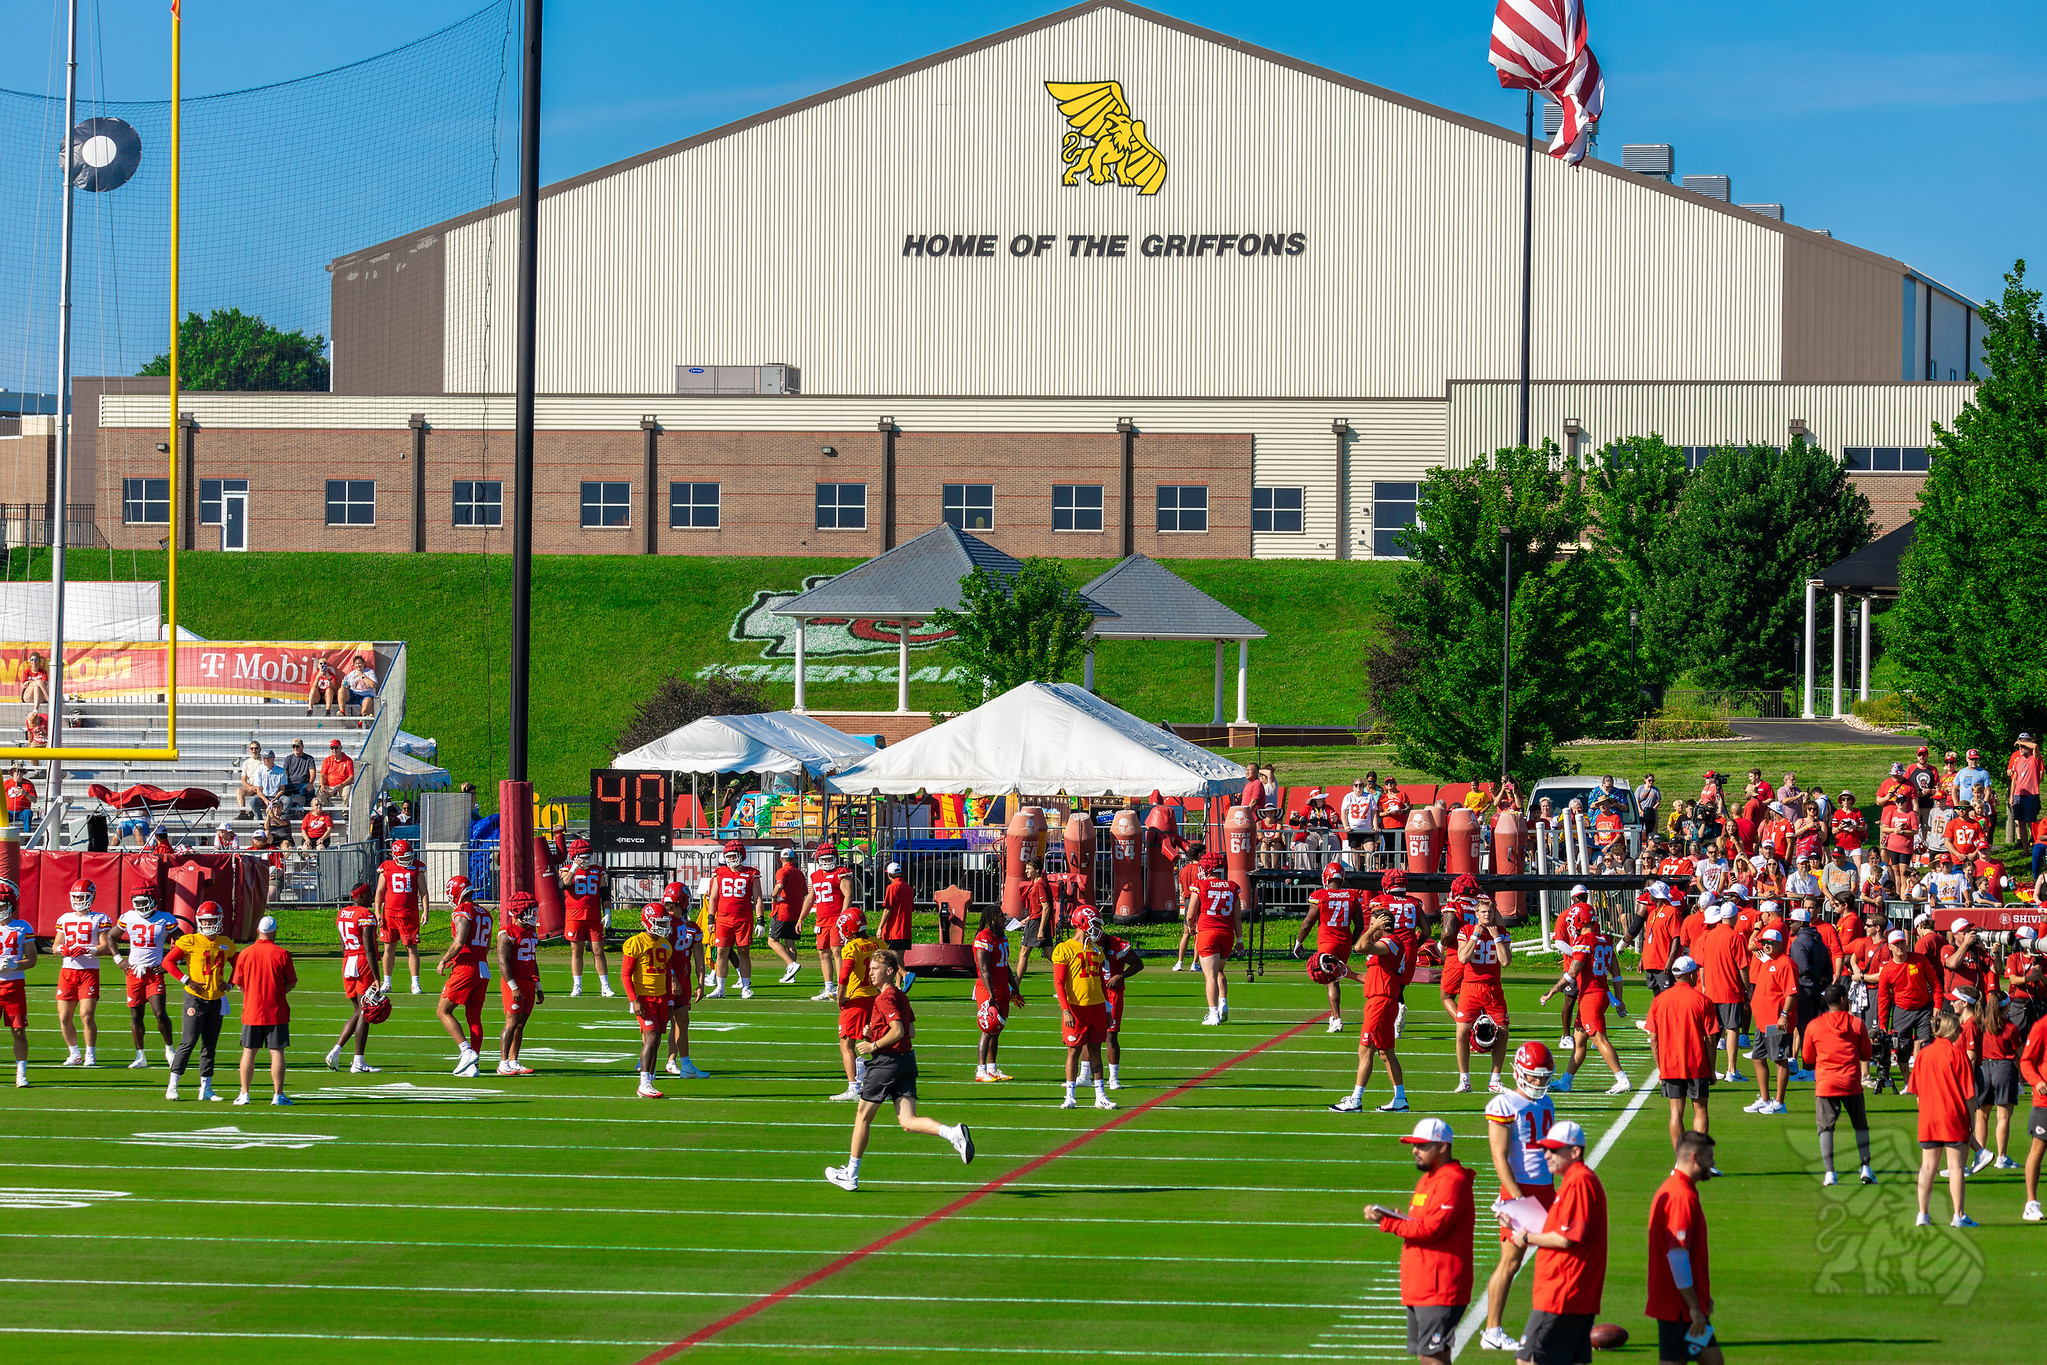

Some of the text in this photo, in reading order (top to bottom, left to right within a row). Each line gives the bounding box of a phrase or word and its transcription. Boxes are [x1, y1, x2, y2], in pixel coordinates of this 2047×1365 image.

[903, 233, 1307, 257] HOME OF THE GRIFFONS
[233, 653, 336, 684] Mobi
[598, 774, 664, 826] 40
[1351, 803, 1370, 819] 87
[1934, 819, 1945, 834] 15
[1955, 829, 1975, 845] 87
[1020, 846, 1038, 861] 64
[1115, 845, 1135, 860] 64
[1230, 838, 1251, 854] 64
[1409, 841, 1430, 856] 64
[1471, 843, 1479, 858] 6
[391, 873, 412, 893] 61
[574, 875, 597, 894] 66
[721, 878, 747, 897] 68
[1206, 891, 1234, 916] 73
[1327, 901, 1349, 927] 71
[1389, 903, 1416, 929] 79
[0, 931, 18, 955] 4
[64, 922, 92, 946] 59
[132, 924, 156, 947] 31
[338, 921, 360, 950] 15
[471, 915, 492, 947] 12
[203, 950, 224, 975] 14
[646, 948, 667, 974] 19
[1470, 940, 1497, 964] 88
[863, 957, 873, 987] 1
[1078, 951, 1100, 978] 15
